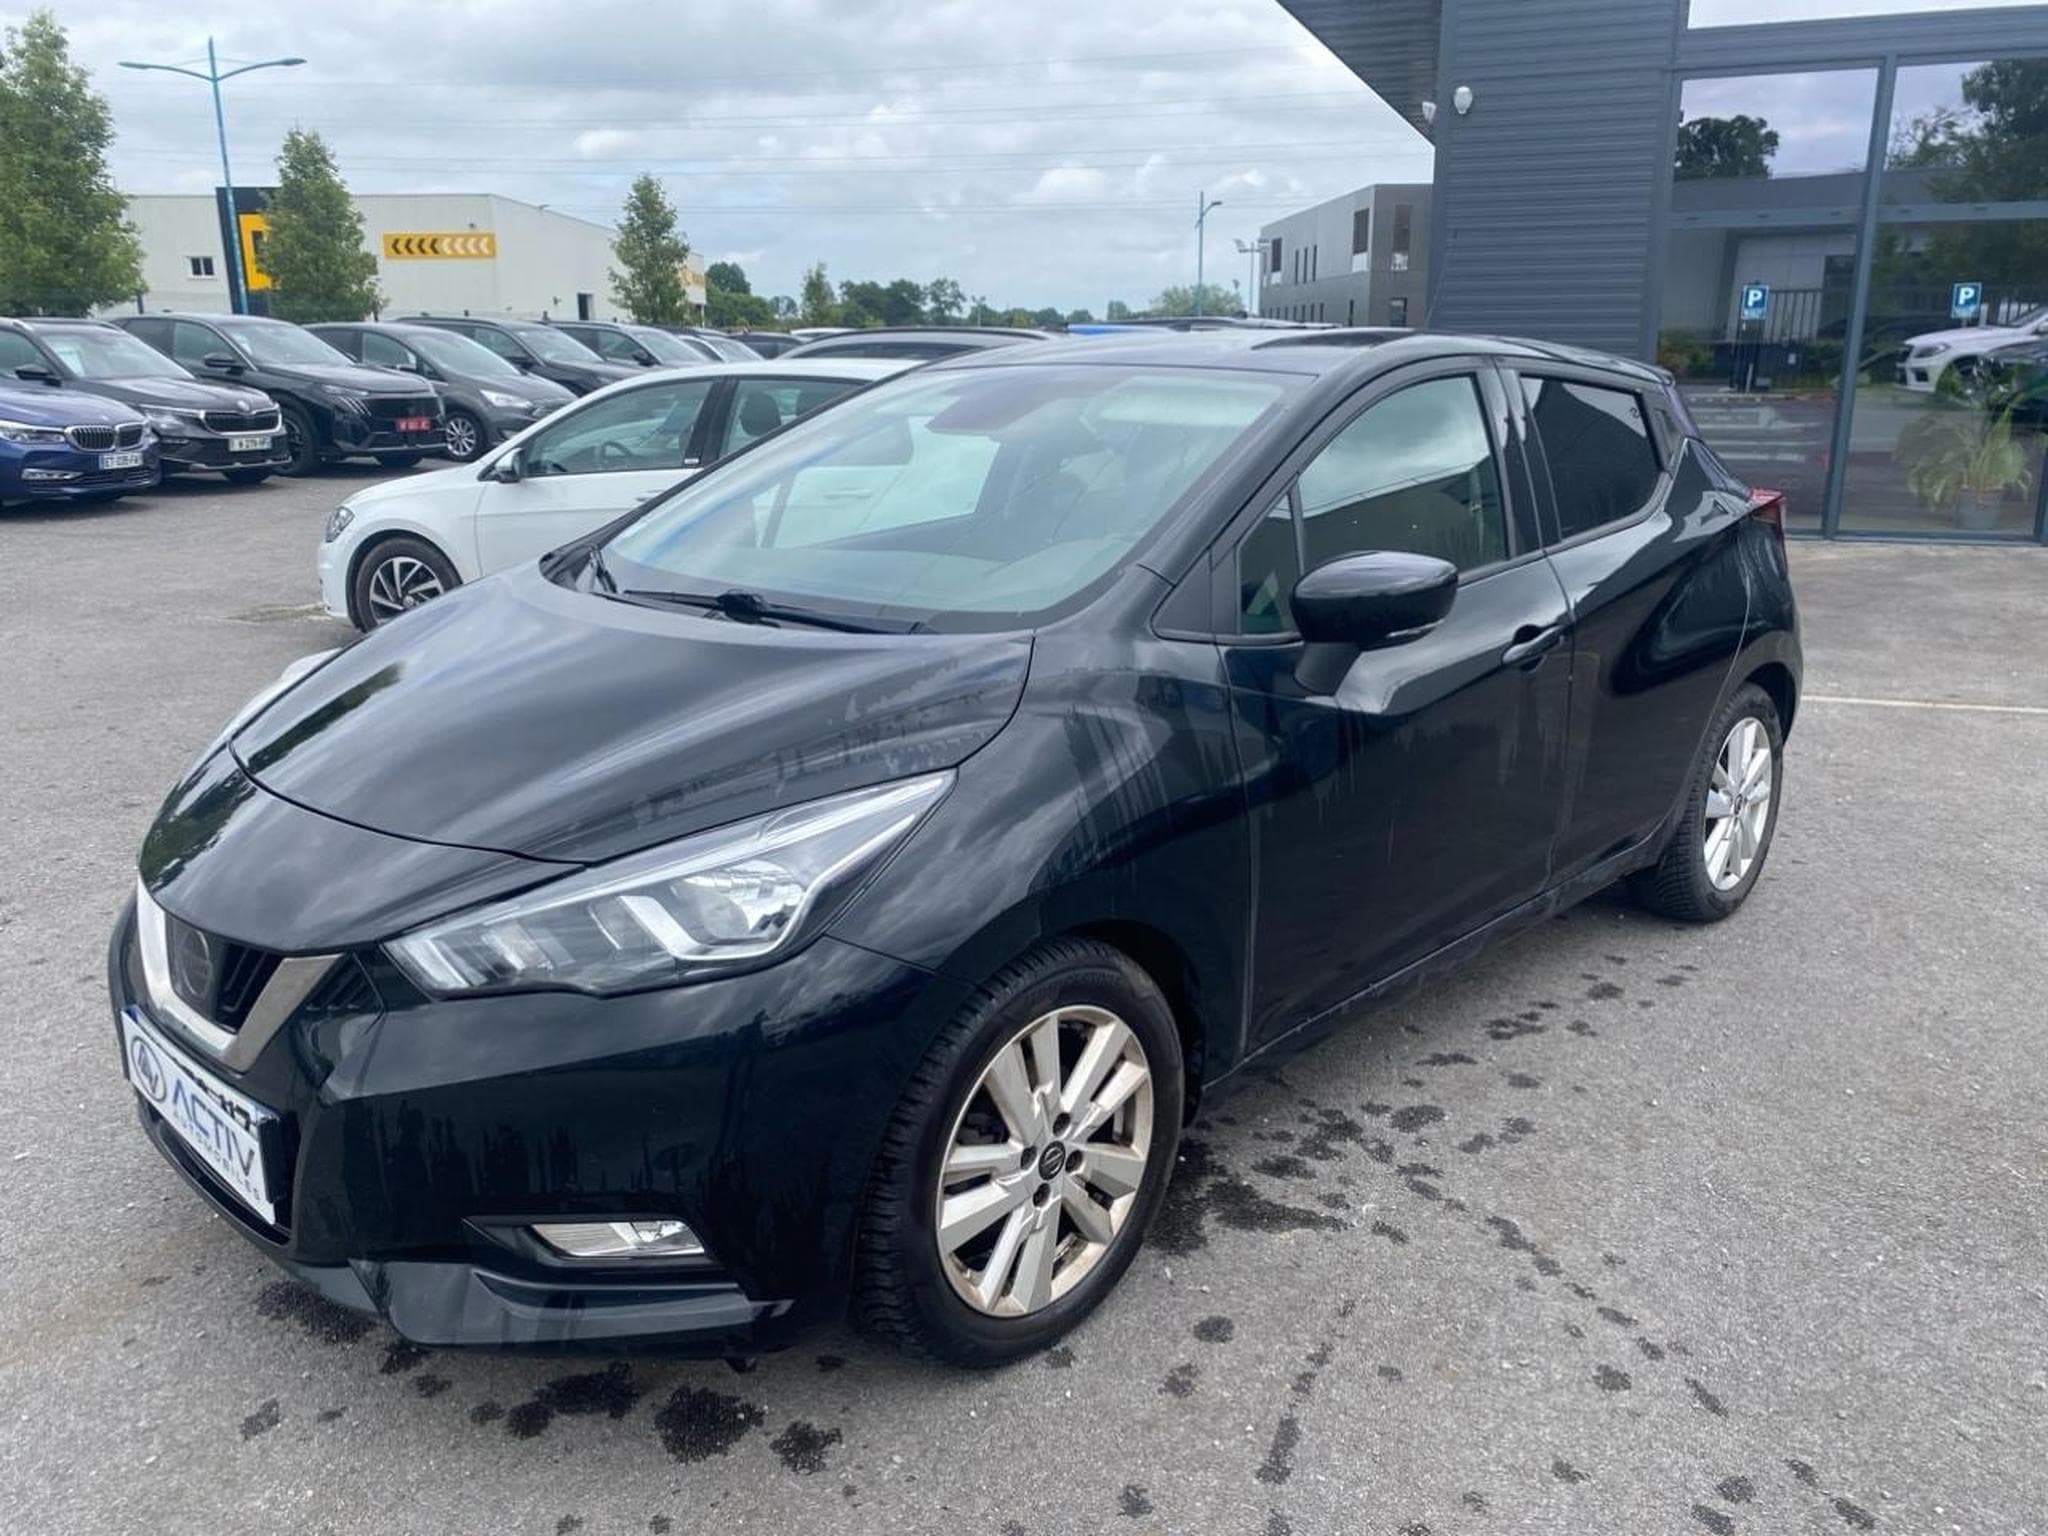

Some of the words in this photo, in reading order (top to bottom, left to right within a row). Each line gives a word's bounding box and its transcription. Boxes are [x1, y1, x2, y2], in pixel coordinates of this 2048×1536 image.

[1747, 289, 1763, 307] P
[1958, 287, 1975, 305] P
[173, 1078, 255, 1177] ACTIV
